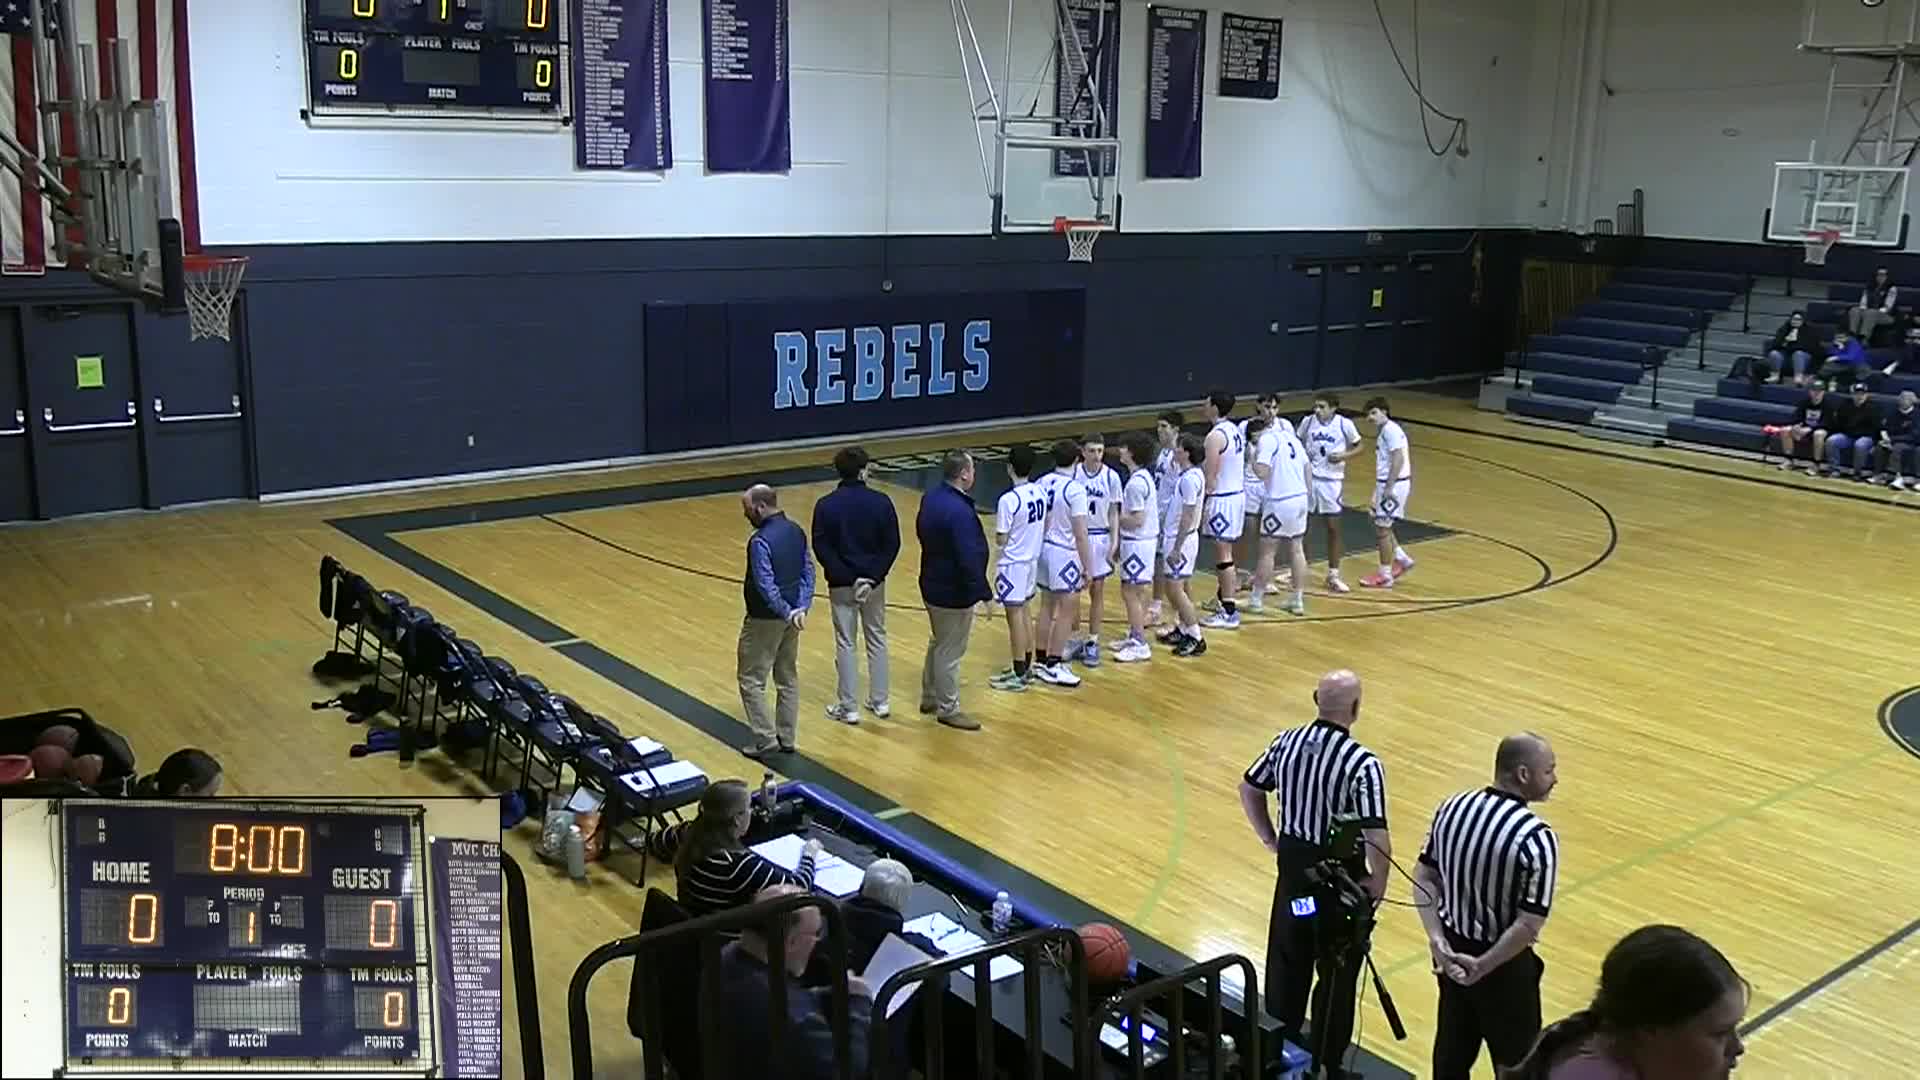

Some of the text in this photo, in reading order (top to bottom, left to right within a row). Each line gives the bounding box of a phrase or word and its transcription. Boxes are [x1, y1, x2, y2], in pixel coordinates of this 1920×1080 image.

[333, 31, 366, 45] FOULS
[452, 38, 481, 51] FOULS
[530, 43, 559, 56] FOULS
[341, 49, 358, 79] 0
[536, 60, 551, 88] 0
[325, 83, 358, 96] POINTS
[773, 319, 992, 410] REBELS
[1027, 498, 1045, 524] 20
[210, 823, 305, 874] 8:00
[452, 842, 479, 856] MVC
[92, 860, 152, 883] HOME
[332, 867, 392, 890] GUEST
[223, 886, 265, 902] PERIOD
[128, 893, 158, 943] 0
[208, 912, 220, 924] TO
[269, 914, 282, 926] TO
[369, 899, 396, 948] 0
[248, 911, 256, 944] 1
[73, 963, 142, 980] TM FOULS
[196, 964, 303, 981] PLAYER FOULS
[350, 967, 414, 983] TM FOULS
[107, 987, 130, 1024] 0
[384, 991, 404, 1027] 0
[85, 1033, 129, 1048] POINTS
[228, 1033, 268, 1048] MATCH
[364, 1035, 405, 1049] POINTS
